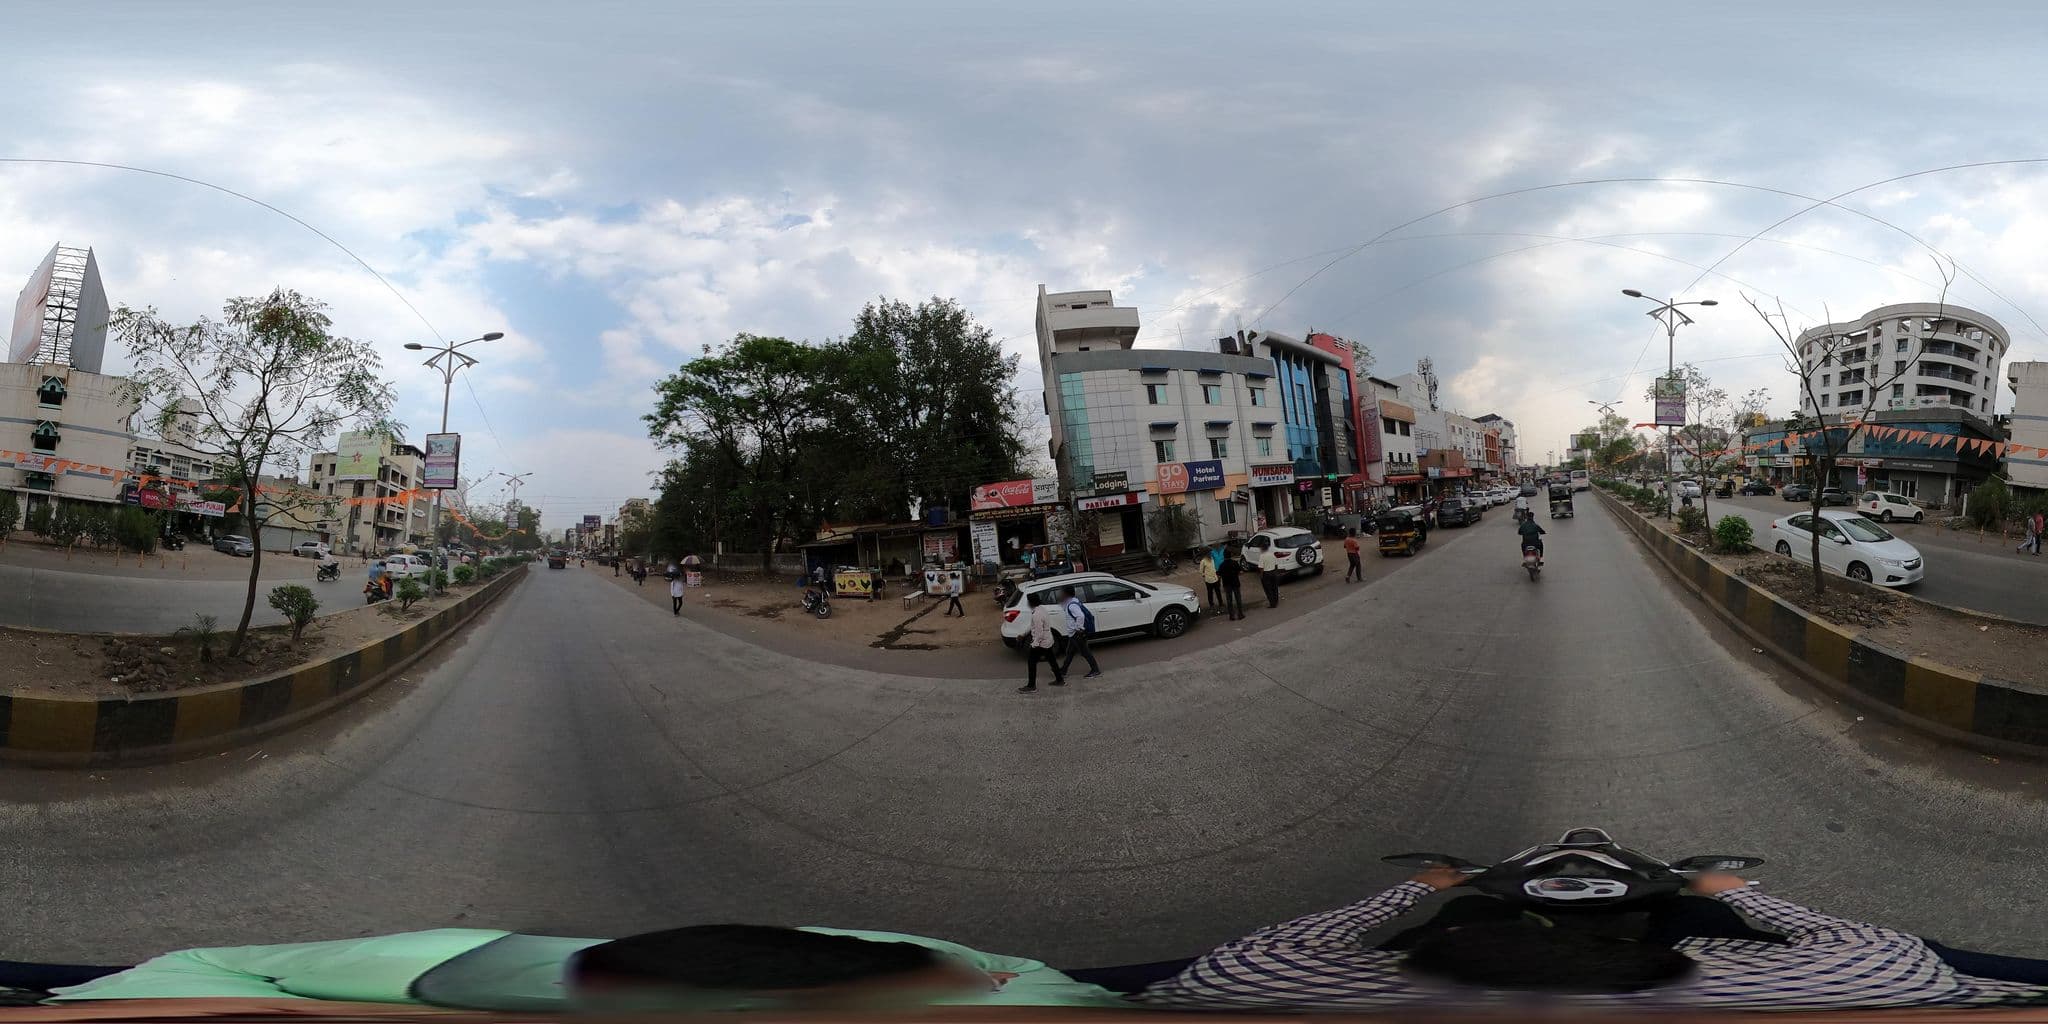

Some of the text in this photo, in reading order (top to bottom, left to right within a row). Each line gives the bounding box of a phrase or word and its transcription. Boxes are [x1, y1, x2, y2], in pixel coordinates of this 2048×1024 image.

[1160, 465, 1182, 481] go
[1195, 466, 1216, 474] Hotel
[1252, 465, 1293, 477] HUMSAFAR
[1193, 475, 1220, 483] Pariwar
[1094, 479, 1128, 490] Lodging
[1163, 480, 1185, 489] STAYS
[1085, 499, 1120, 509] PARIWAR
